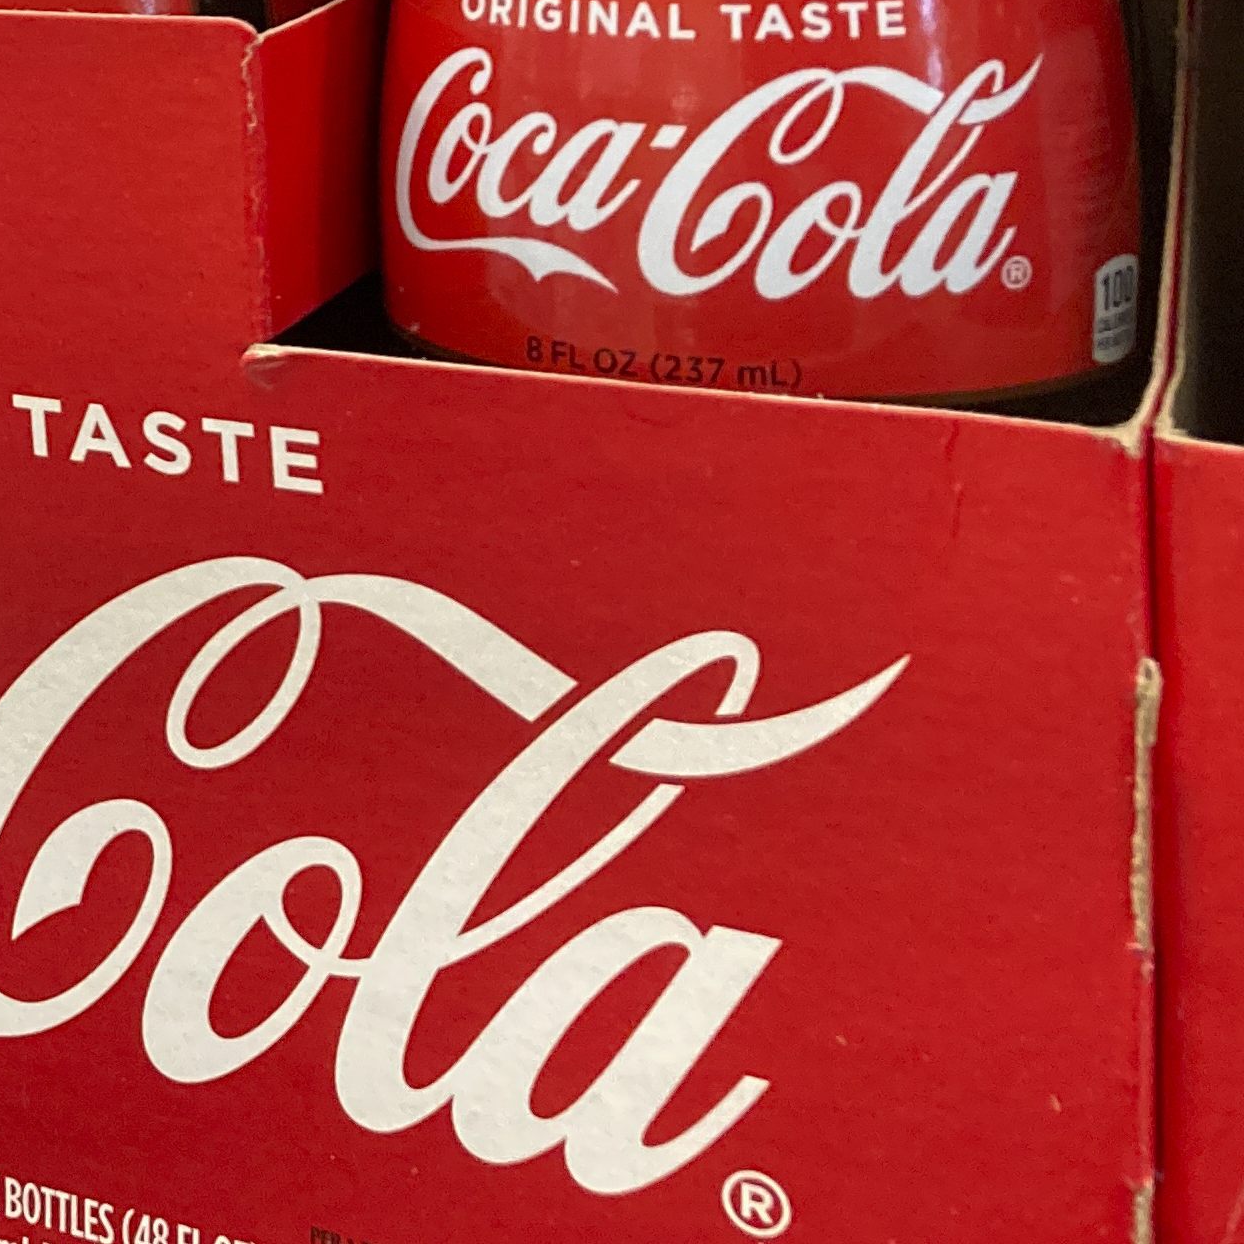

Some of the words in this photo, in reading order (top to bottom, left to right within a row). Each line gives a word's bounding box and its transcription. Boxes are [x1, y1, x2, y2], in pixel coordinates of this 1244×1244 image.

[720, 0, 907, 40] TASTE
[395, 47, 1045, 300] Coca-Cola
[526, 335, 542, 363] 8
[551, 340, 585, 371] FL
[593, 348, 639, 378] OZ
[651, 352, 725, 385] (237
[737, 358, 803, 389] mL)
[12, 394, 325, 495] TASTE
[4, 1176, 115, 1244] BOTTLES
[122, 1208, 170, 1244] (48
